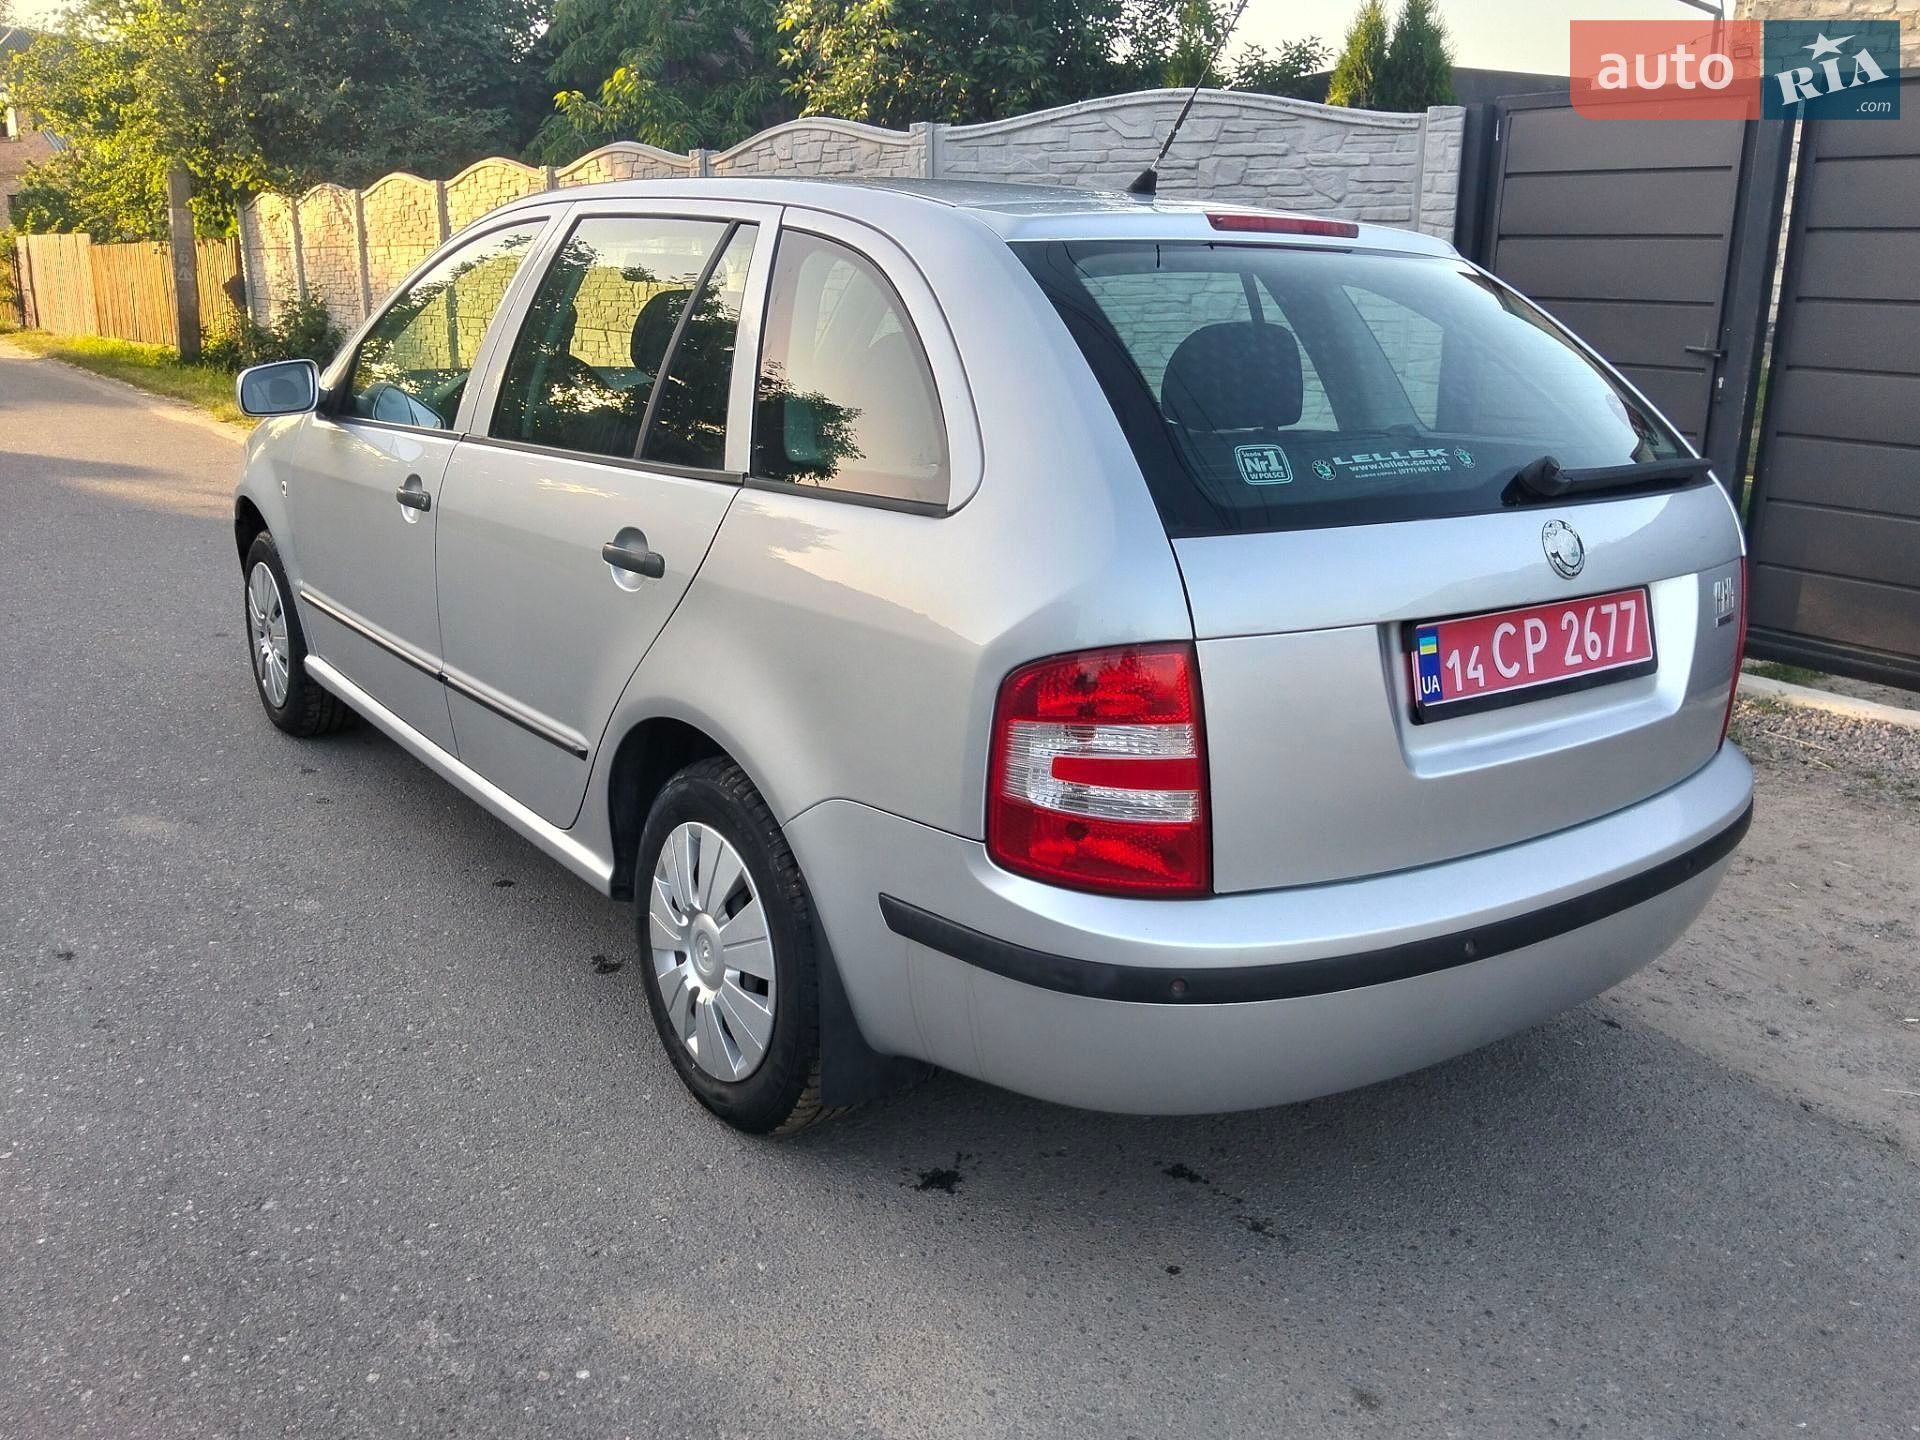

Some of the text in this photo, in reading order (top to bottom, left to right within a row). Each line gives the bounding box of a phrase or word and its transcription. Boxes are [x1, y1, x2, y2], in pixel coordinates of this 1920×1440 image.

[1332, 449, 1449, 465] LELLEK
[1349, 458, 1447, 472] www.lellek.com.pl
[1446, 600, 1636, 691] 14 CP 2677
[1422, 675, 1440, 694] UA
